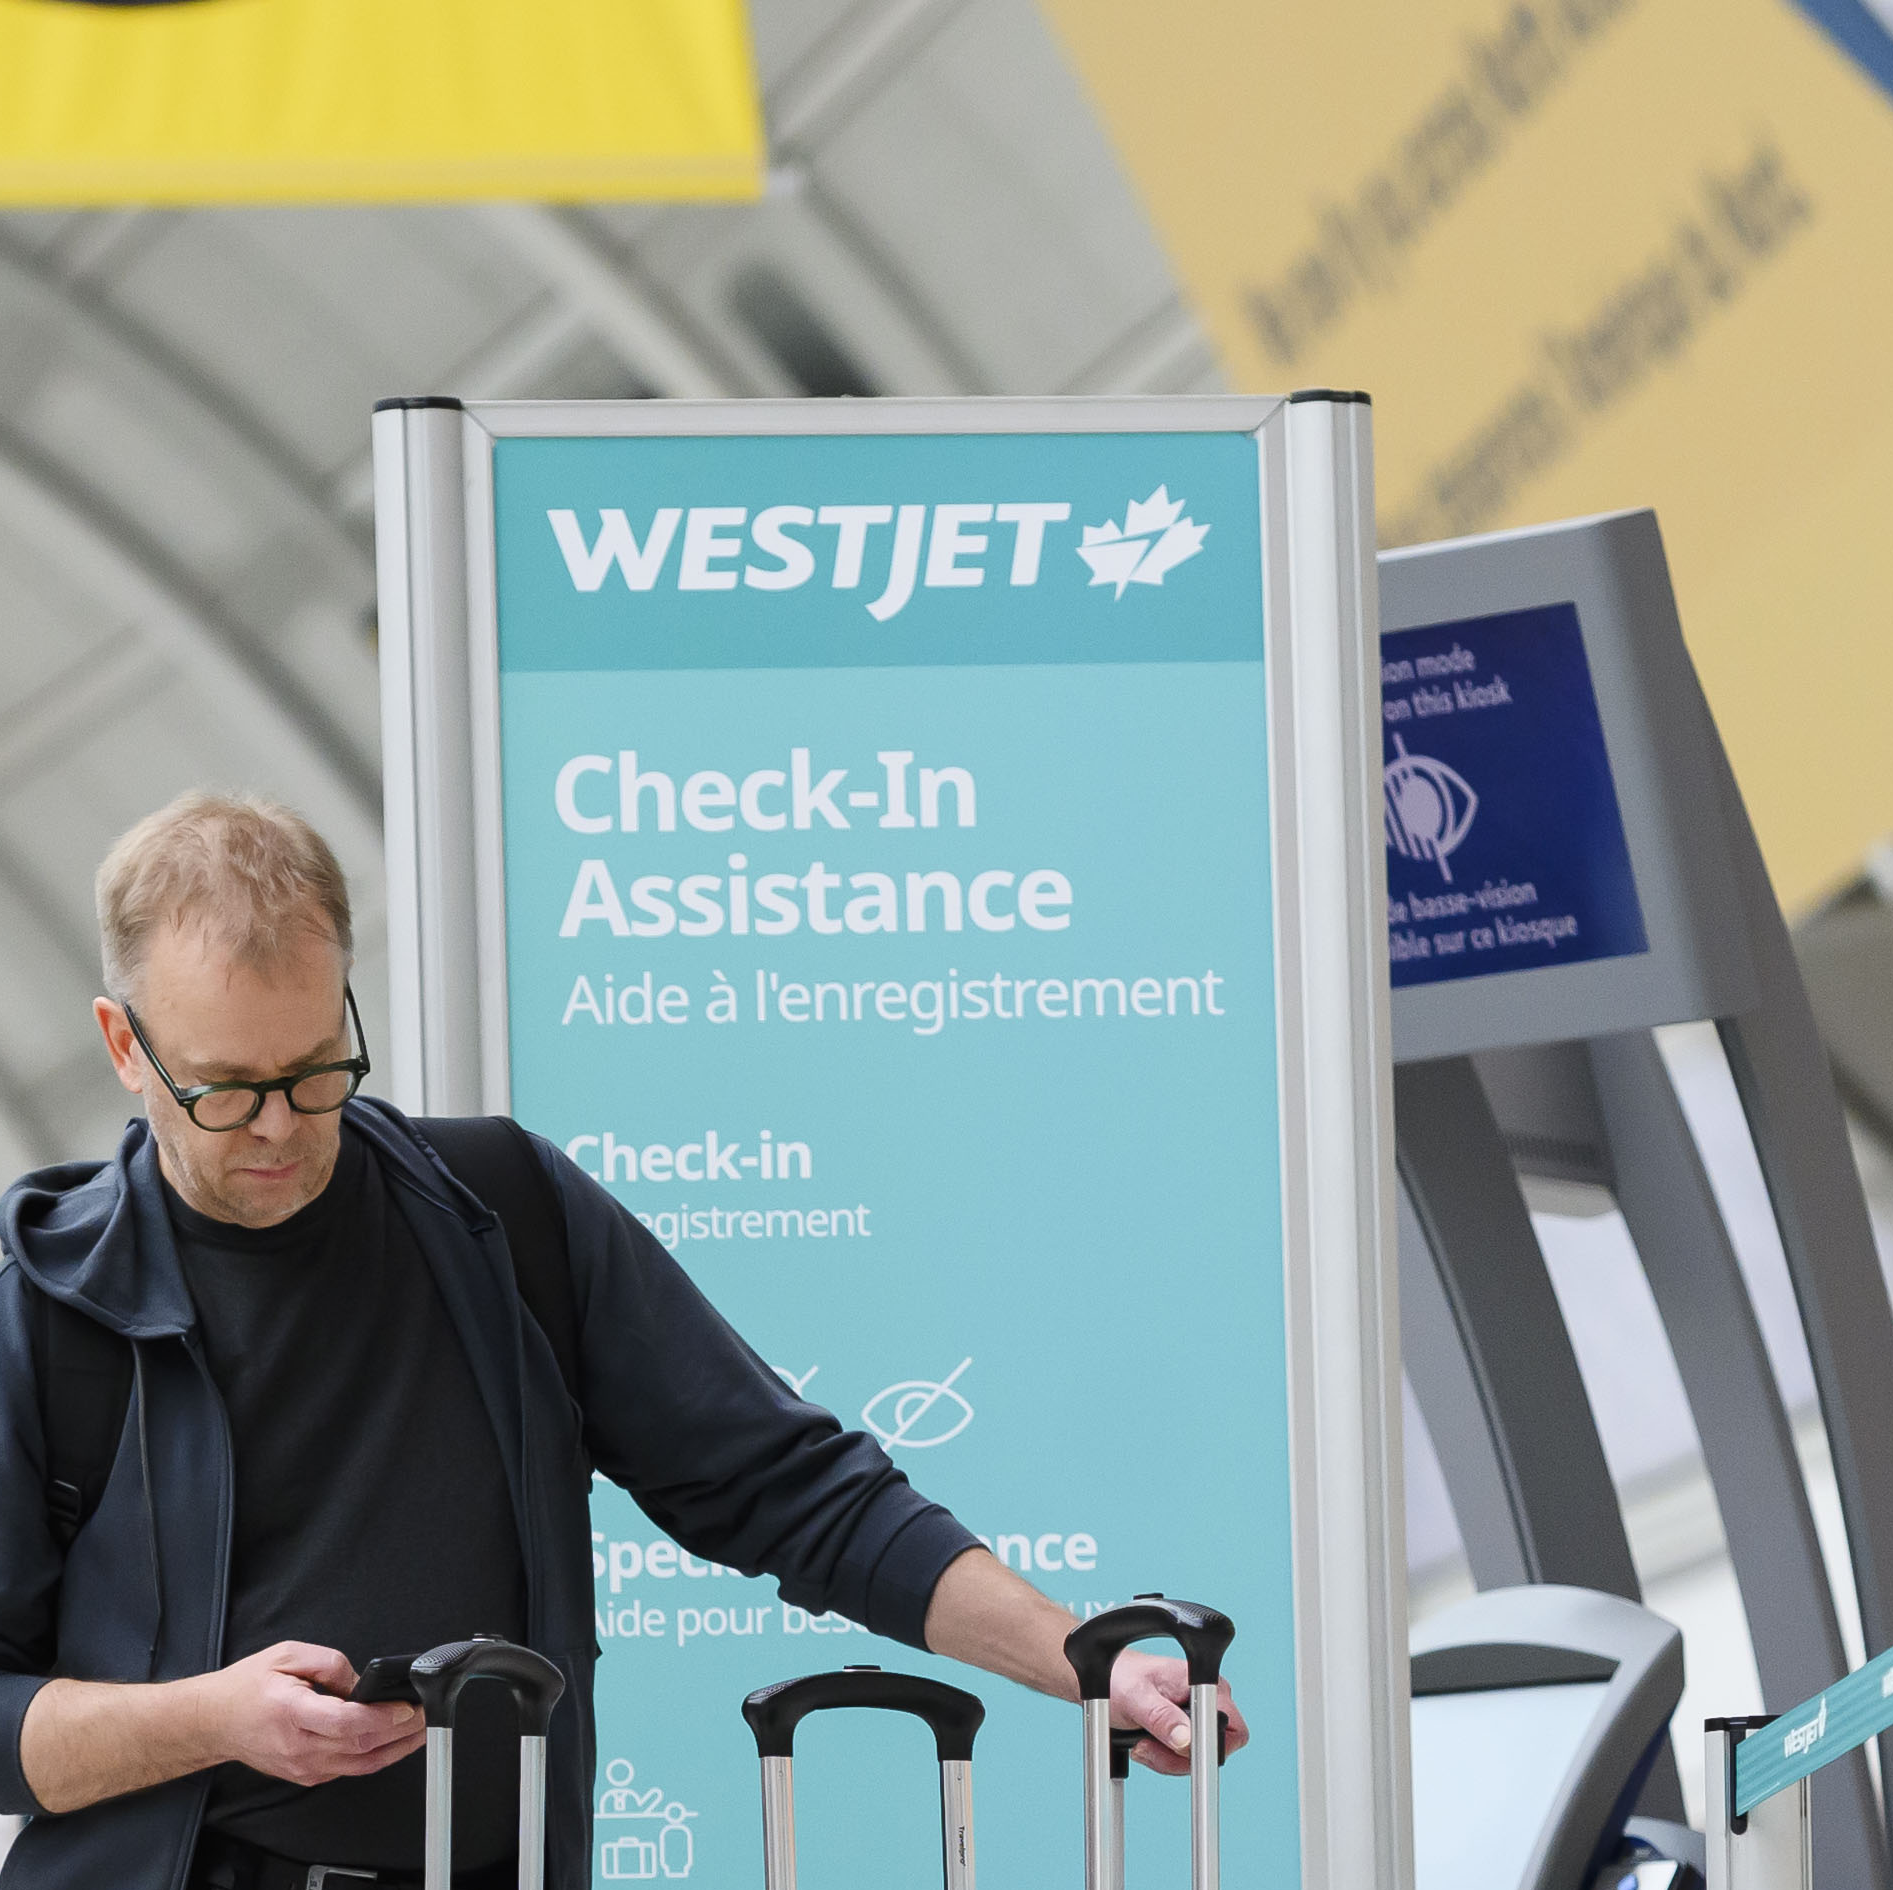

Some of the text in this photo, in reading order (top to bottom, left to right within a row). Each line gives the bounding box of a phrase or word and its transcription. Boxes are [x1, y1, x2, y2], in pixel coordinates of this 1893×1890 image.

[546, 501, 1072, 623] WESTJET
[1454, 674, 1513, 710] kiosk
[553, 746, 978, 836] Check-In
[557, 852, 1074, 939] Assistance
[1494, 914, 1579, 949] kiosque
[561, 967, 1226, 1037] Aide à l'enregistrement
[564, 1128, 813, 1184] Check-in
[635, 1203, 872, 1252] egistrement
[677, 1606, 773, 1648] pour
